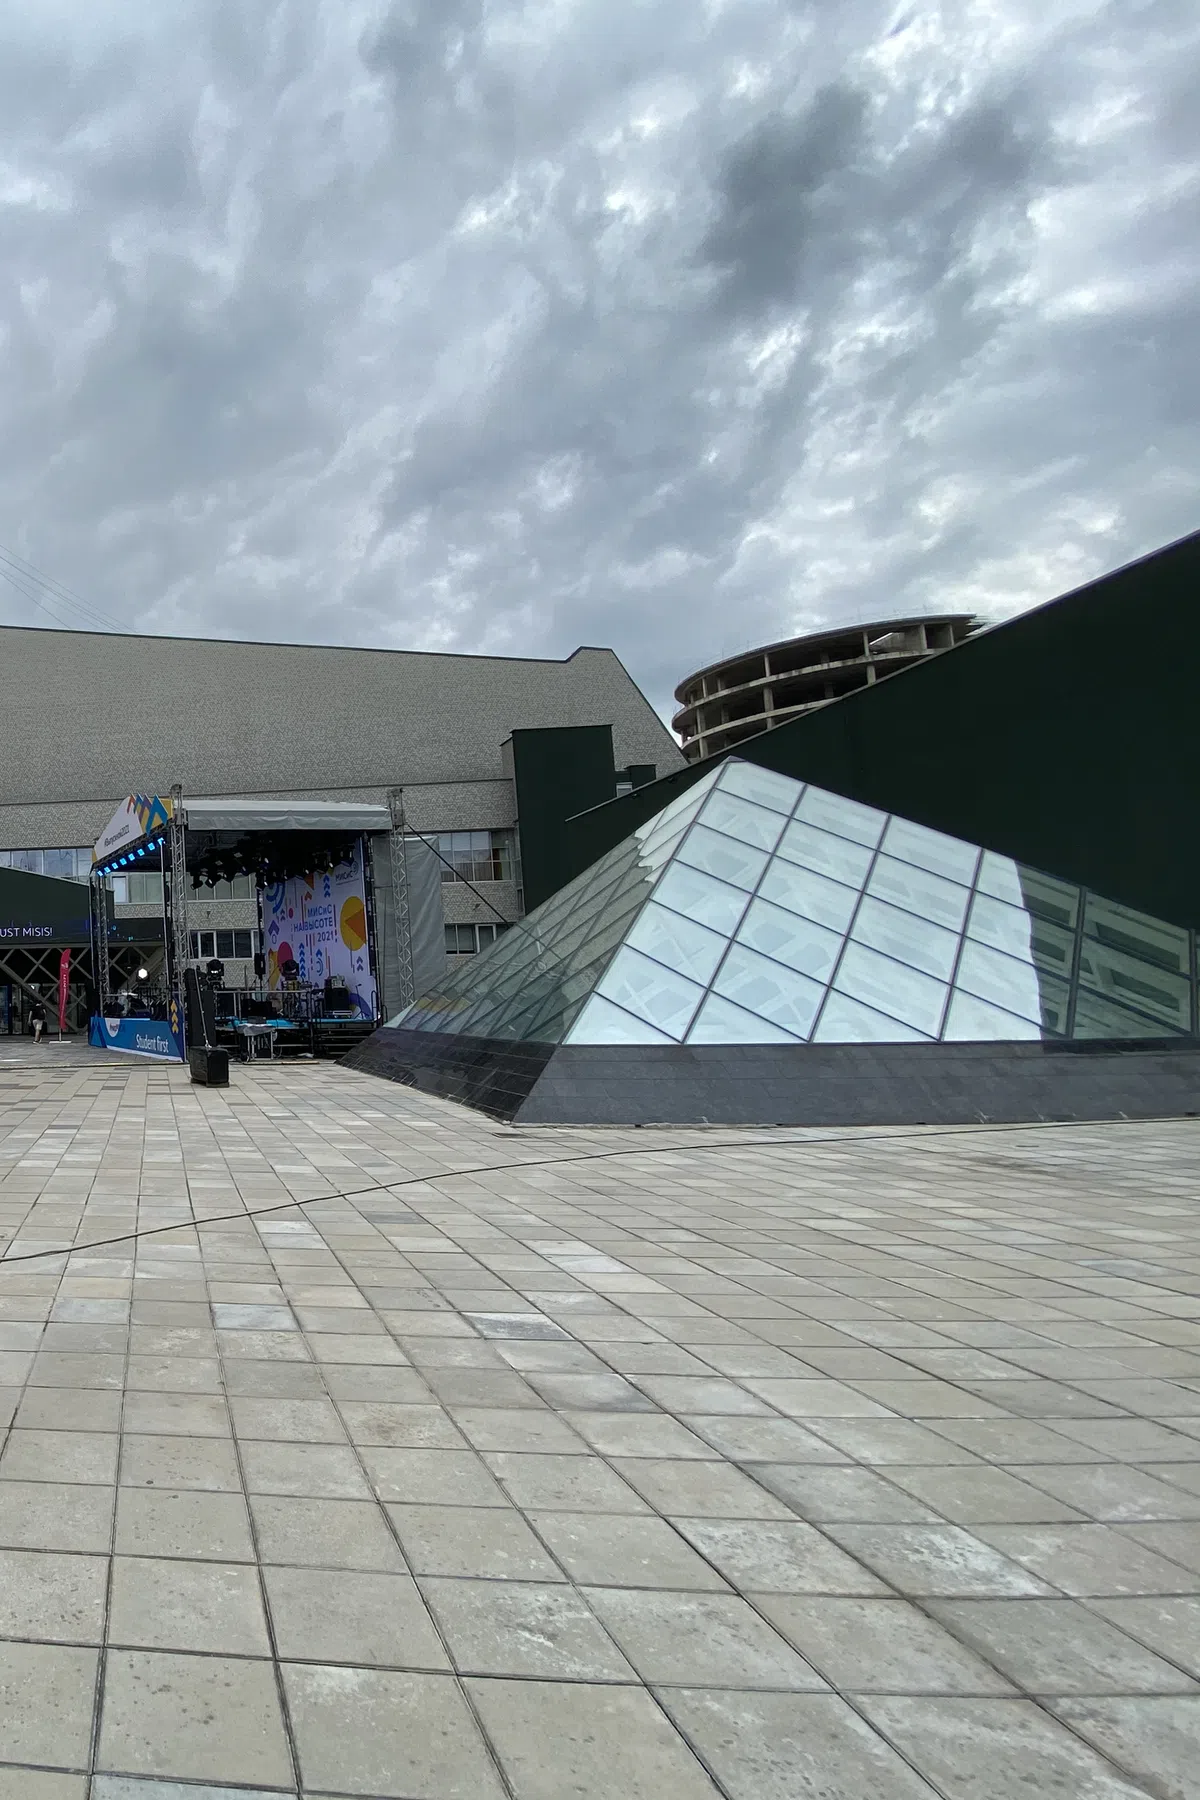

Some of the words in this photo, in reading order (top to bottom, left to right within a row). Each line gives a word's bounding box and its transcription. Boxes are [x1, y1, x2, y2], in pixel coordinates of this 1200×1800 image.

[307, 904, 332, 917] МИСиС
[22, 926, 53, 937] MISIS!
[136, 1033, 157, 1052] Student
[156, 1035, 169, 1054] first
